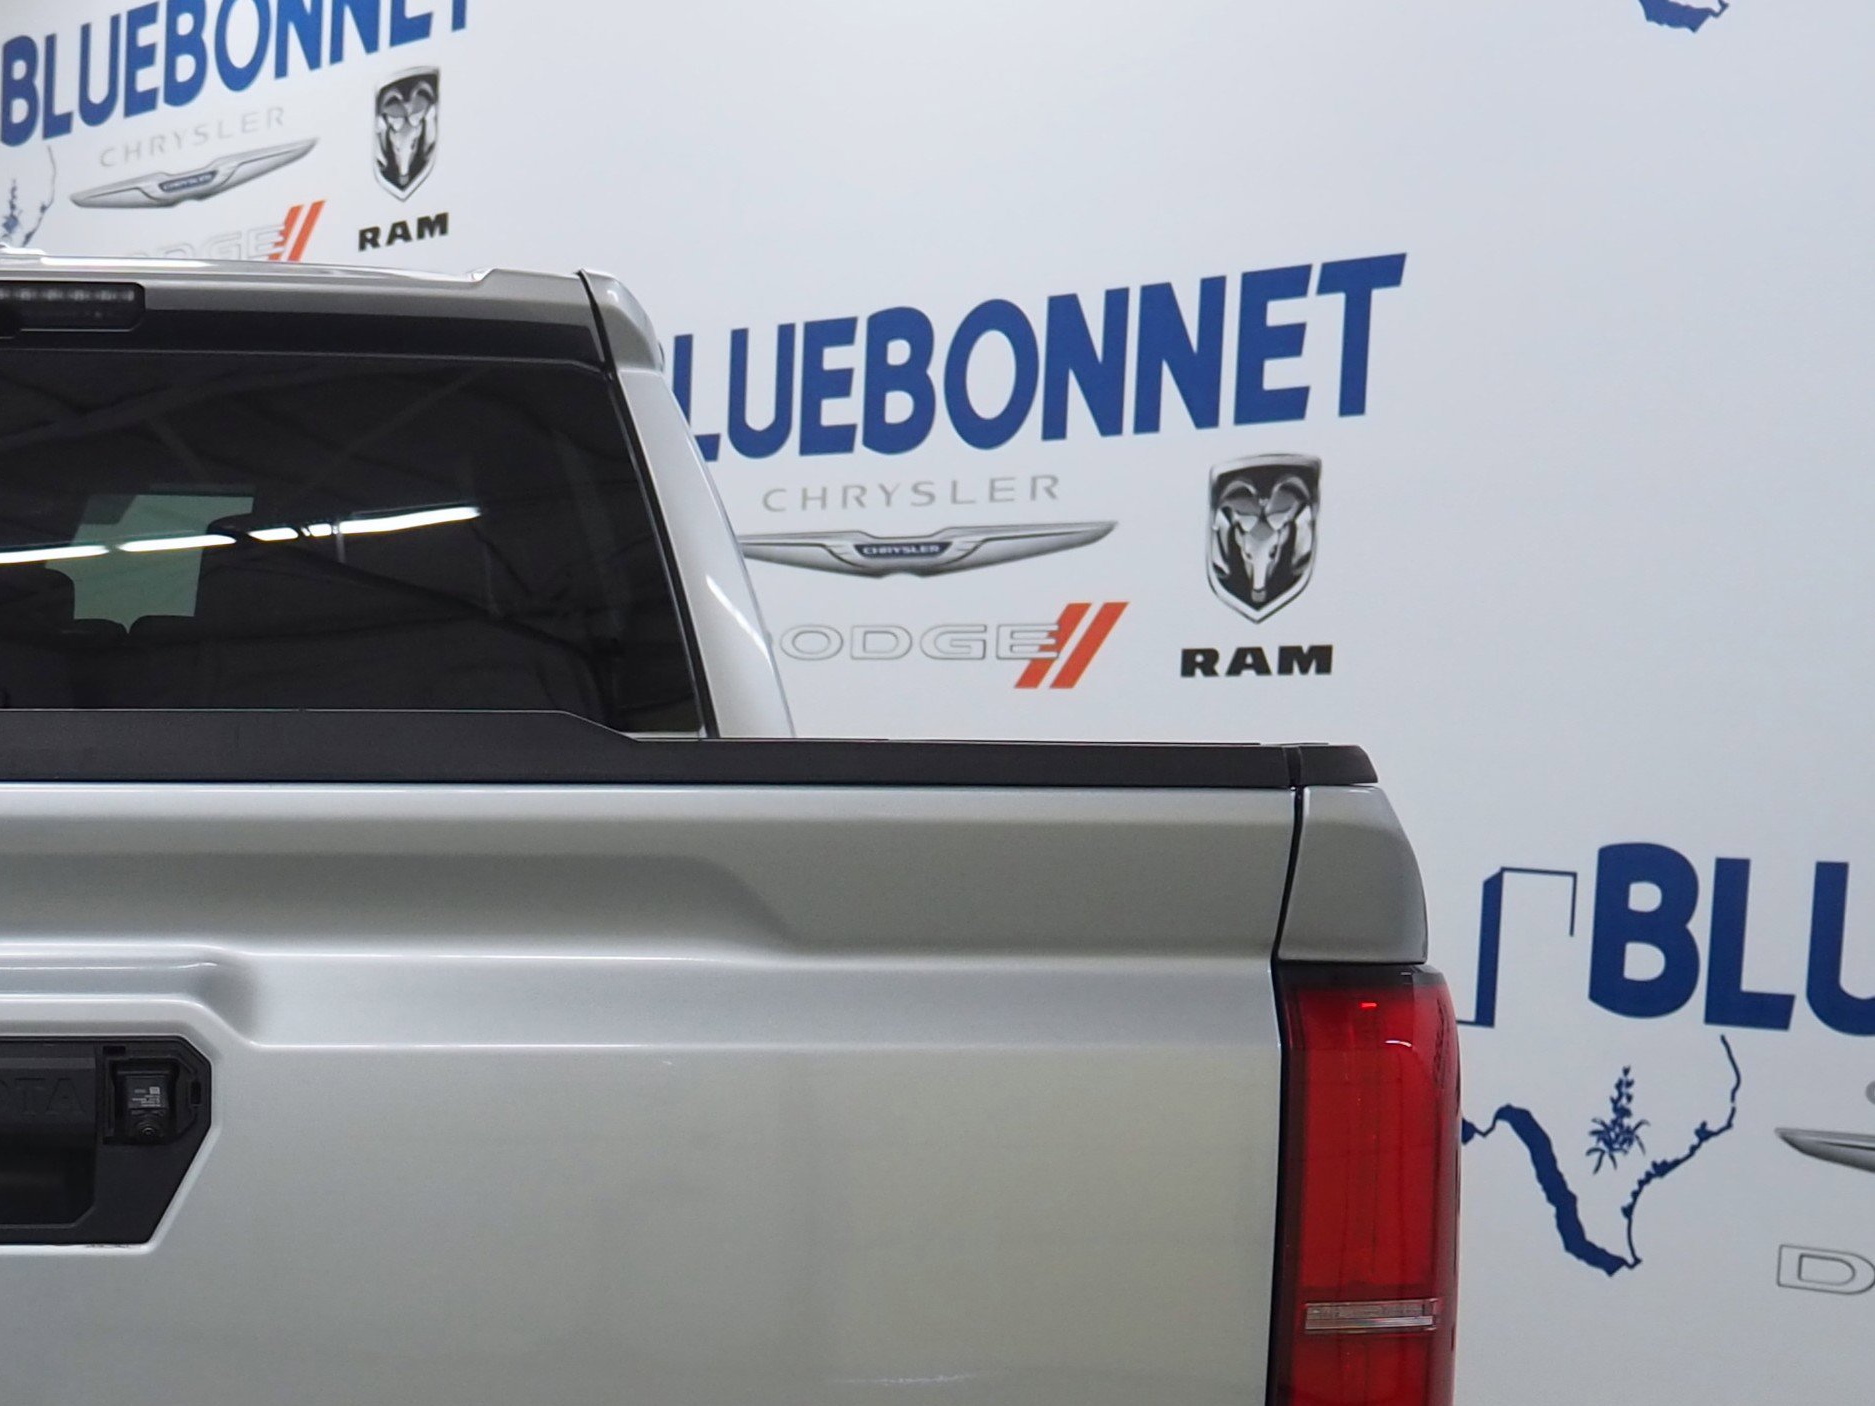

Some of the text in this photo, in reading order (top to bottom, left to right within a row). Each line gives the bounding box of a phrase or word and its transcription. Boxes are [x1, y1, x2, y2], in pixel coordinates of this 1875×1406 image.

[0, 0, 468, 148] BLUEBONN
[99, 106, 285, 168] CHRYSLER
[358, 211, 450, 253] RAM
[673, 252, 1408, 462] LUEBONNET
[761, 474, 1060, 513] CHRYSLER
[862, 544, 941, 556] CHRYSLER
[778, 623, 1060, 661] ODGE
[1180, 644, 1334, 678] RAM
